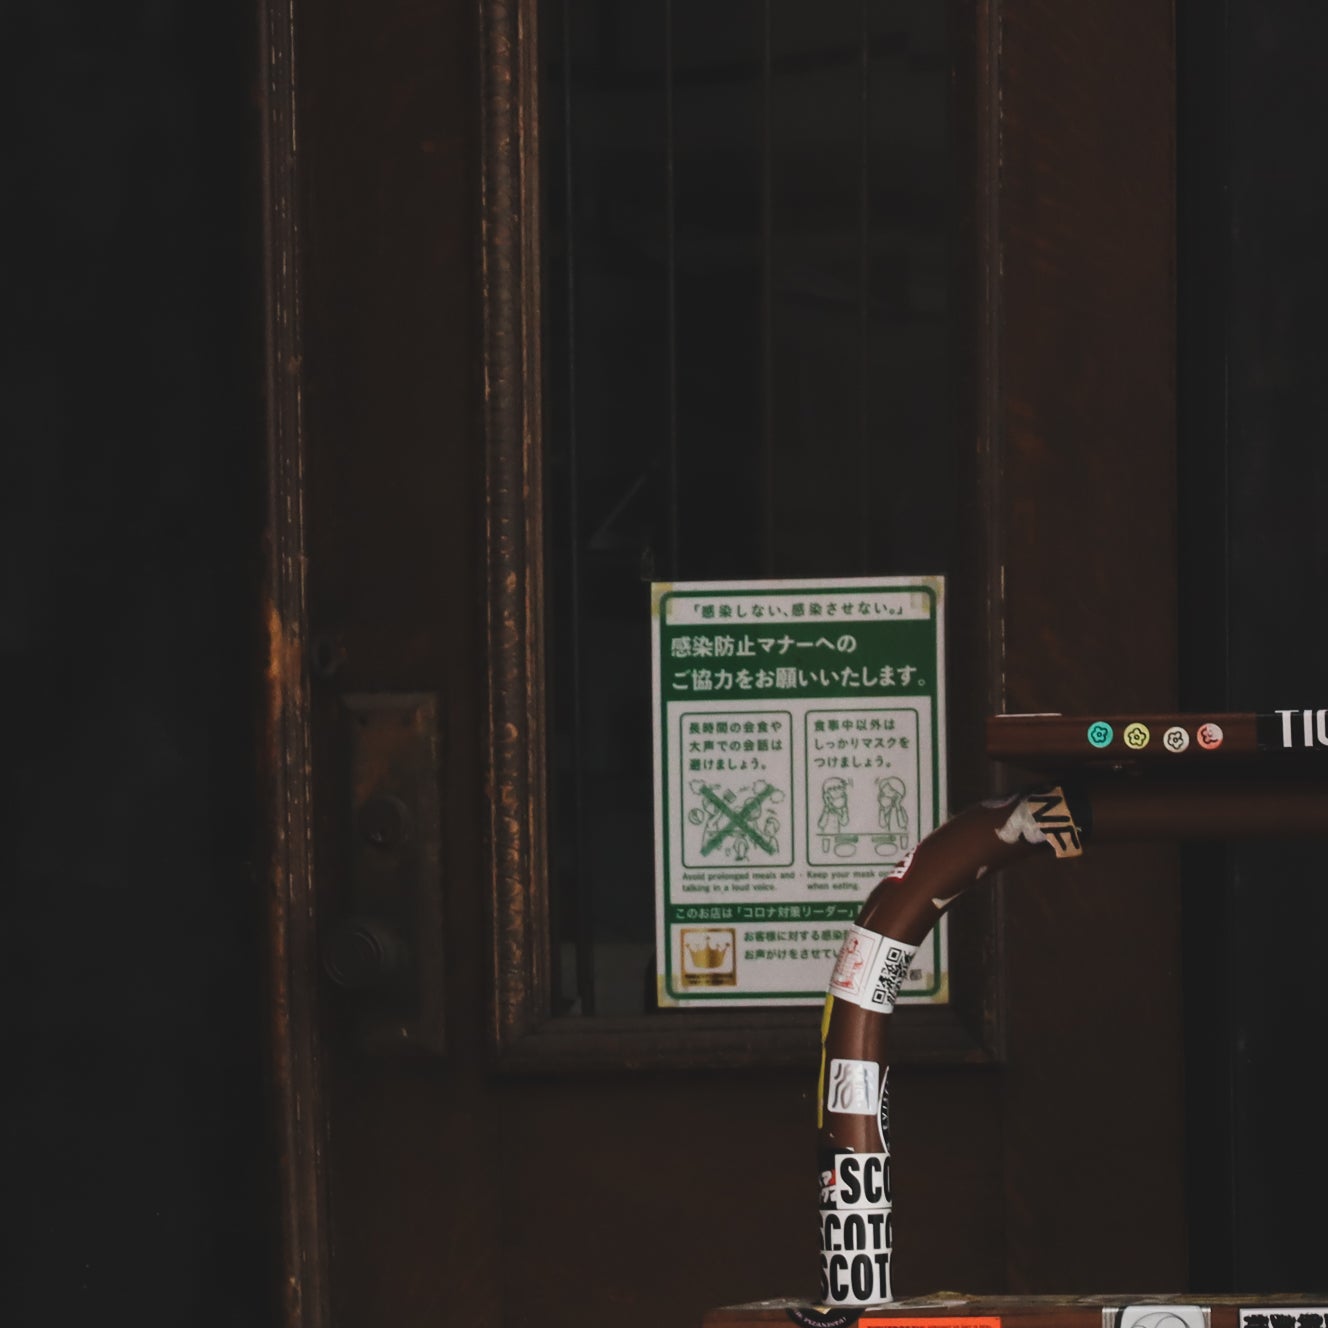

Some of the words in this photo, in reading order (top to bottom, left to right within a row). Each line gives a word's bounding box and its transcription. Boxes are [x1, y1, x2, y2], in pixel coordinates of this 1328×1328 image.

[671, 634, 857, 658] 感染防止マナーへの
[672, 664, 926, 691] ご協力をお願いいたします。
[676, 905, 862, 920] このお店は「コロナ対策リーダー」
